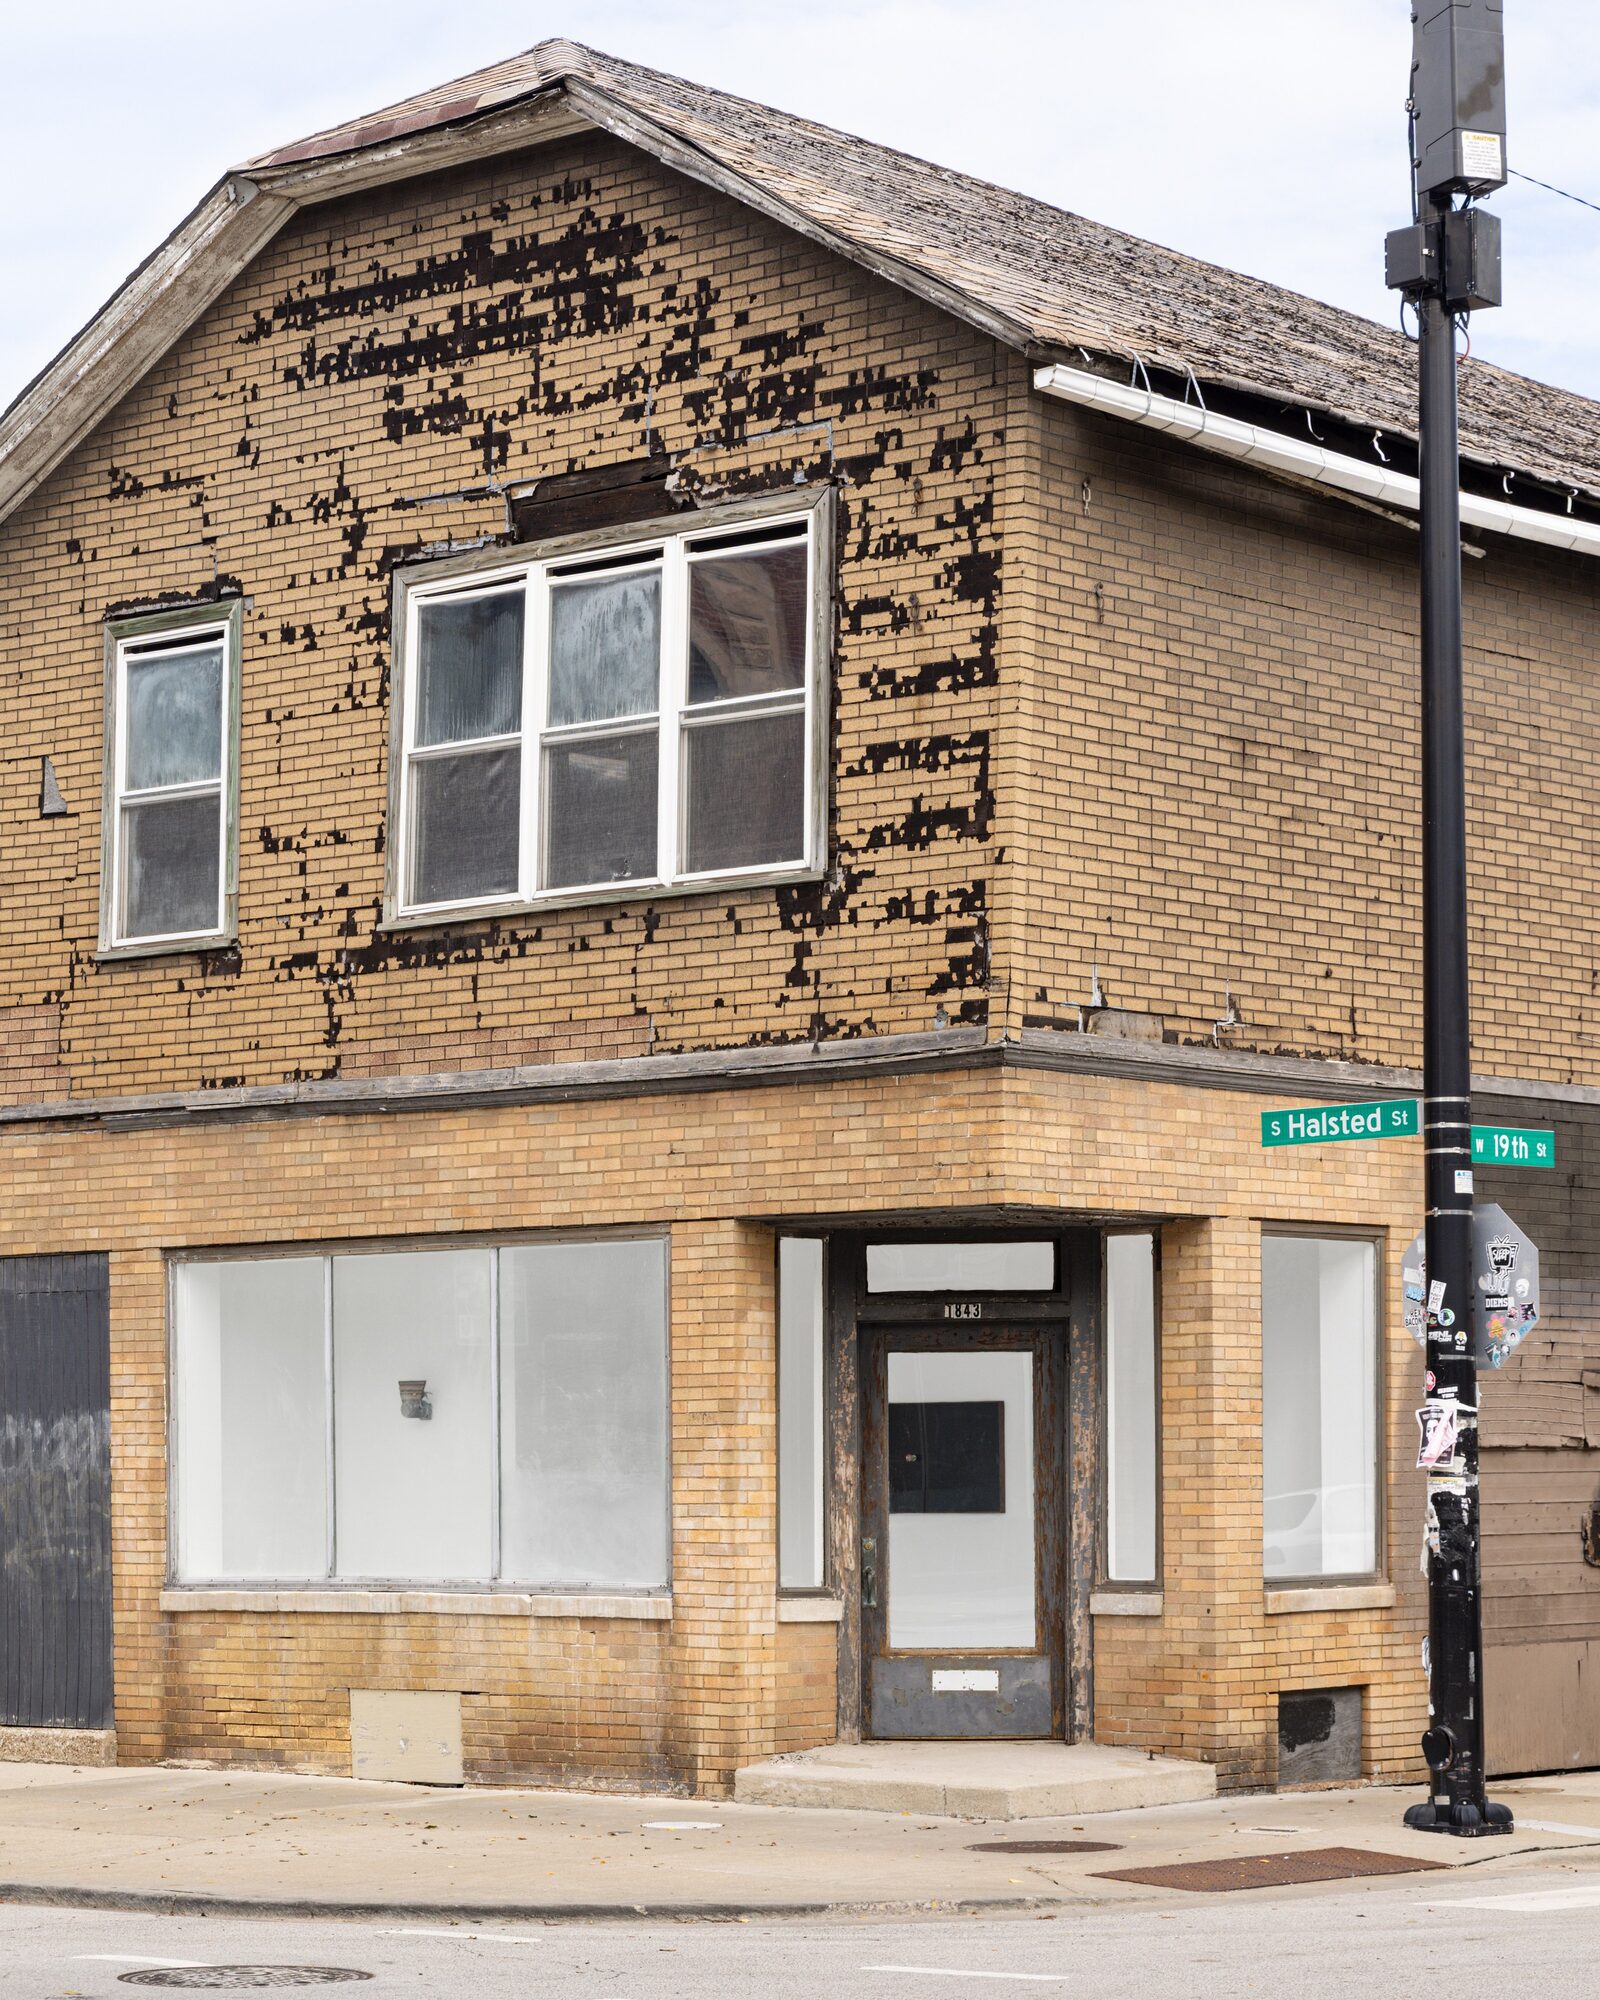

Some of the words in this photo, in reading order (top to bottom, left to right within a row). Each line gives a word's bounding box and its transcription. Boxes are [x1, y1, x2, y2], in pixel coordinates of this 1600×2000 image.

[1271, 1120, 1281, 1136] S
[1288, 1107, 1382, 1139] Halsted
[1391, 1109, 1409, 1127] St
[1475, 1137, 1484, 1153] W
[1493, 1134, 1529, 1159] 19th
[1536, 1141, 1547, 1157] St
[946, 1304, 980, 1318] 1843
